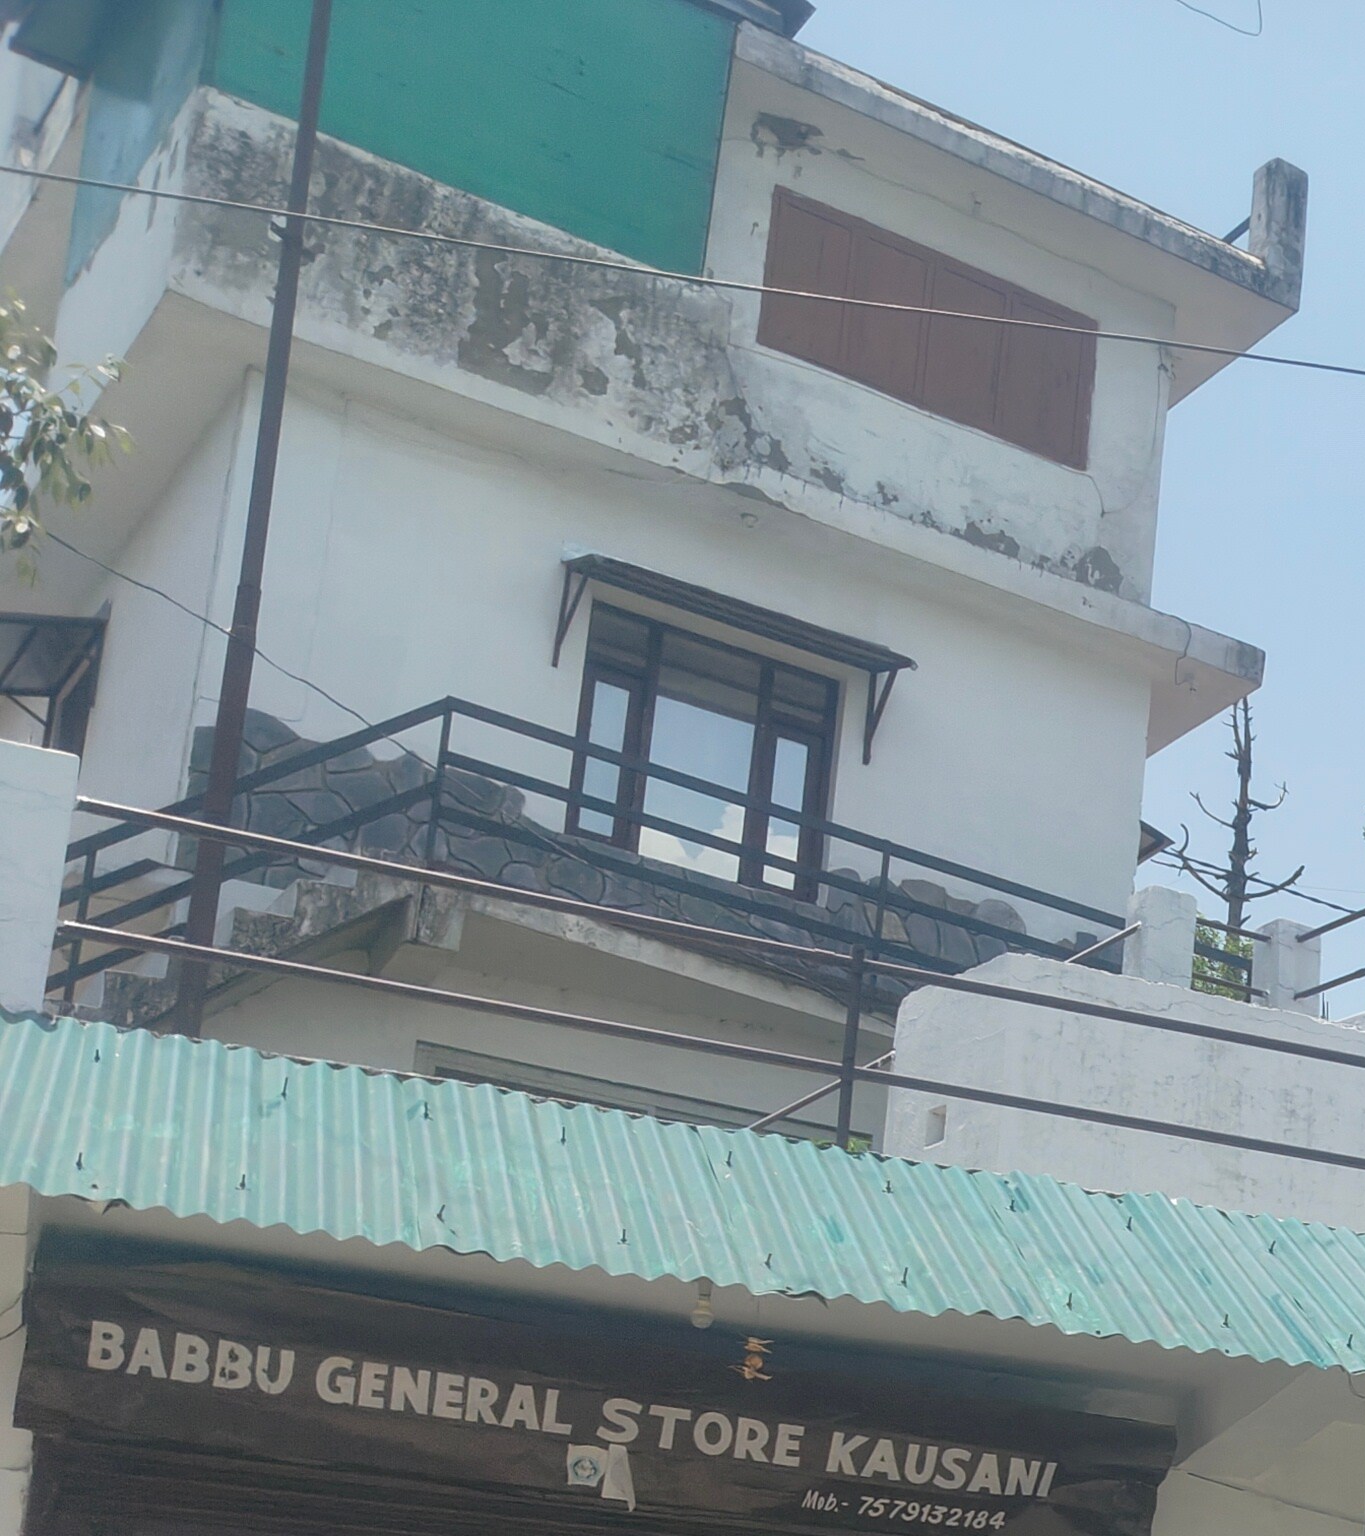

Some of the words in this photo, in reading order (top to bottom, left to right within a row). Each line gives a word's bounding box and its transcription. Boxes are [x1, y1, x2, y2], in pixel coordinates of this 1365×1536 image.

[87, 1320, 296, 1395] BABBU
[315, 1355, 573, 1436] GENERAL
[595, 1397, 806, 1467] STORE
[824, 1431, 1059, 1498] KAUSANI
[857, 1495, 1006, 1531] 7579132184
